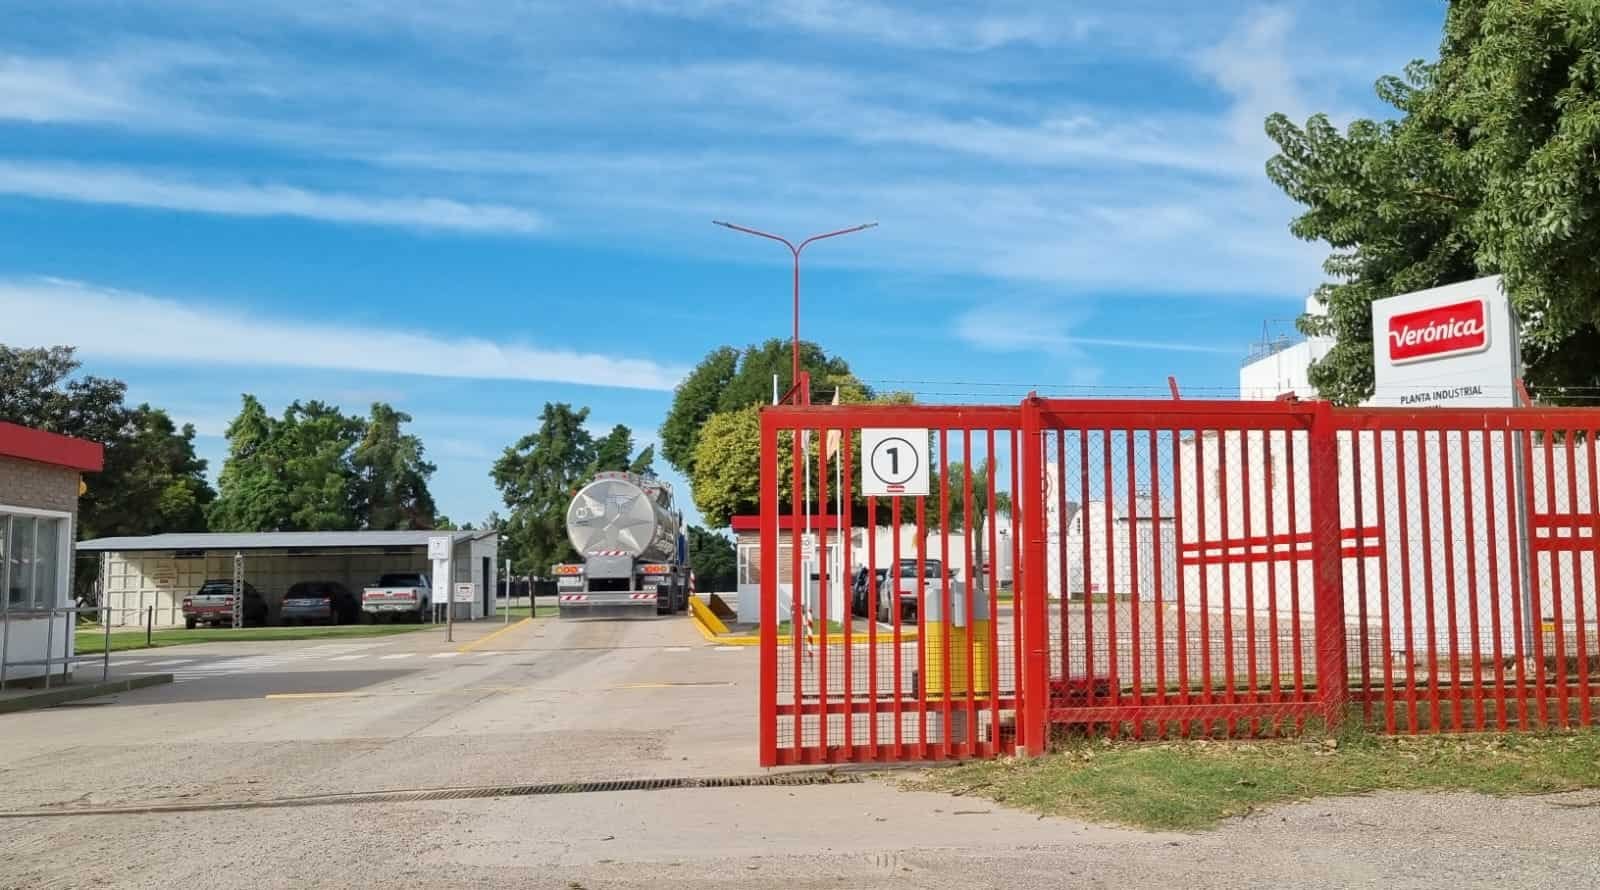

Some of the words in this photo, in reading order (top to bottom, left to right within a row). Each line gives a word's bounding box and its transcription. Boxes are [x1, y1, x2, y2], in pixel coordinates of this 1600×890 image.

[1390, 318, 1485, 348] Verónica
[1400, 393, 1431, 405] PLANTA
[1433, 385, 1482, 400] INDUSTRIAL
[886, 447, 898, 475] 1
